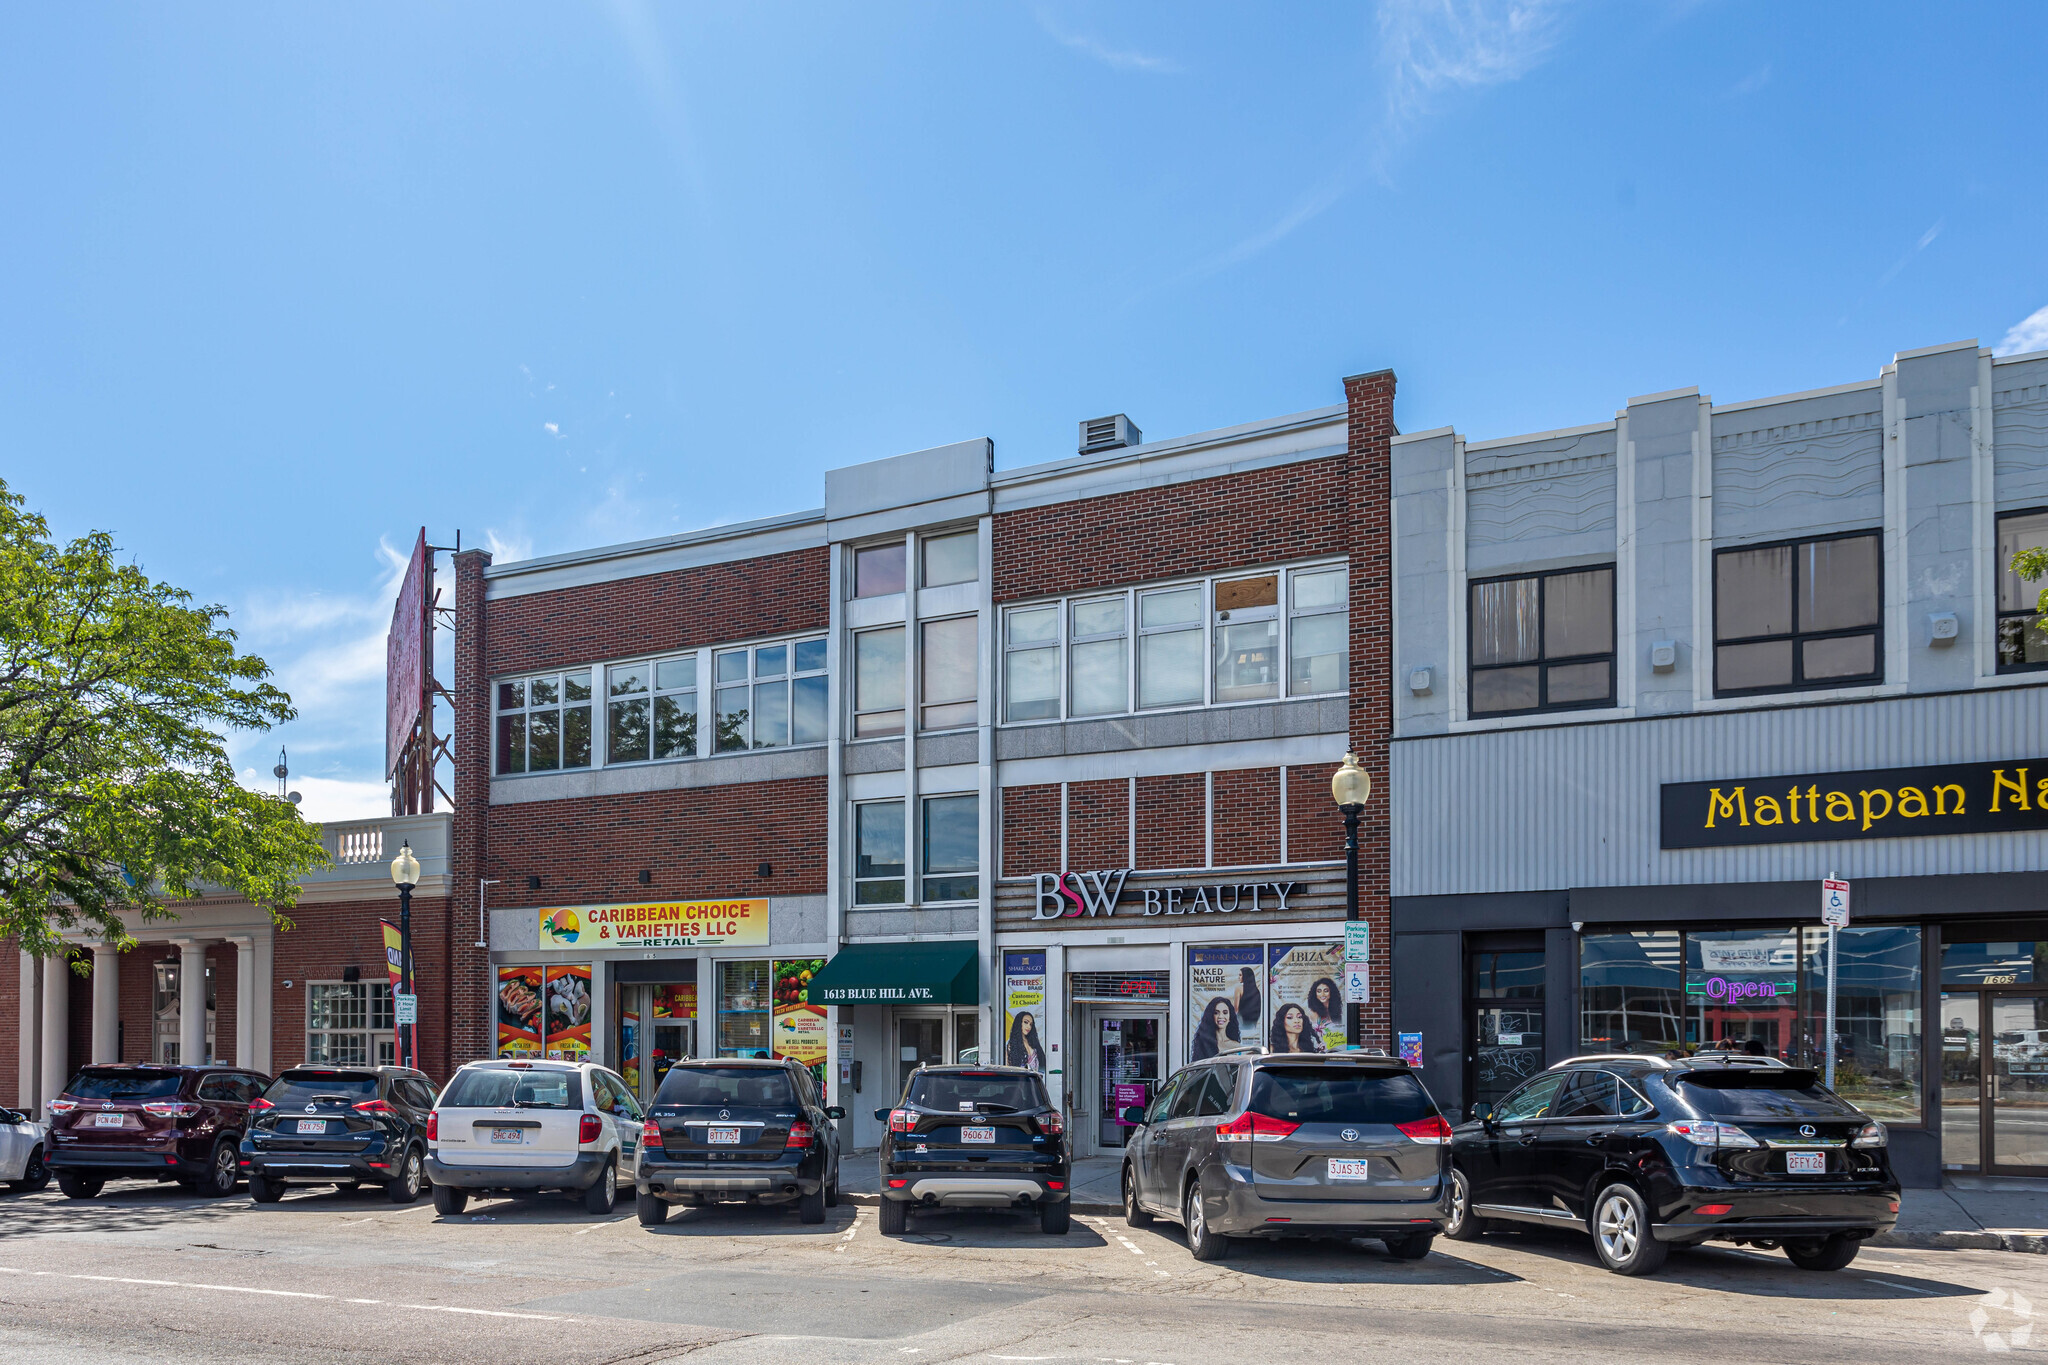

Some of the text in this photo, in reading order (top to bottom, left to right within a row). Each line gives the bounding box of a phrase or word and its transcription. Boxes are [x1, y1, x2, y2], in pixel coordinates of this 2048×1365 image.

[1704, 784, 1966, 831] Mattapan
[1032, 868, 1295, 920] BSW BEAUTY
[588, 904, 750, 923] CARIBBEAN CHOICE
[600, 921, 737, 939] & VARIETIES LLC
[643, 938, 695, 947] RETAIL
[1291, 952, 1324, 962] IBIZA
[1193, 968, 1223, 976] NAKED
[1985, 976, 2014, 984] 1609
[1120, 981, 1156, 994] OPEN
[1707, 977, 1776, 1004] Open
[824, 988, 933, 999] 1613 BLUE HILL AVE.
[840, 1029, 852, 1038] KJS
[507, 1132, 520, 1140] 494
[709, 1131, 725, 1140] 8TT
[963, 1130, 994, 1140] 9606 ZK
[1789, 1157, 1824, 1169] 2FFY 26
[1330, 1164, 1366, 1175] 3JAS 35
